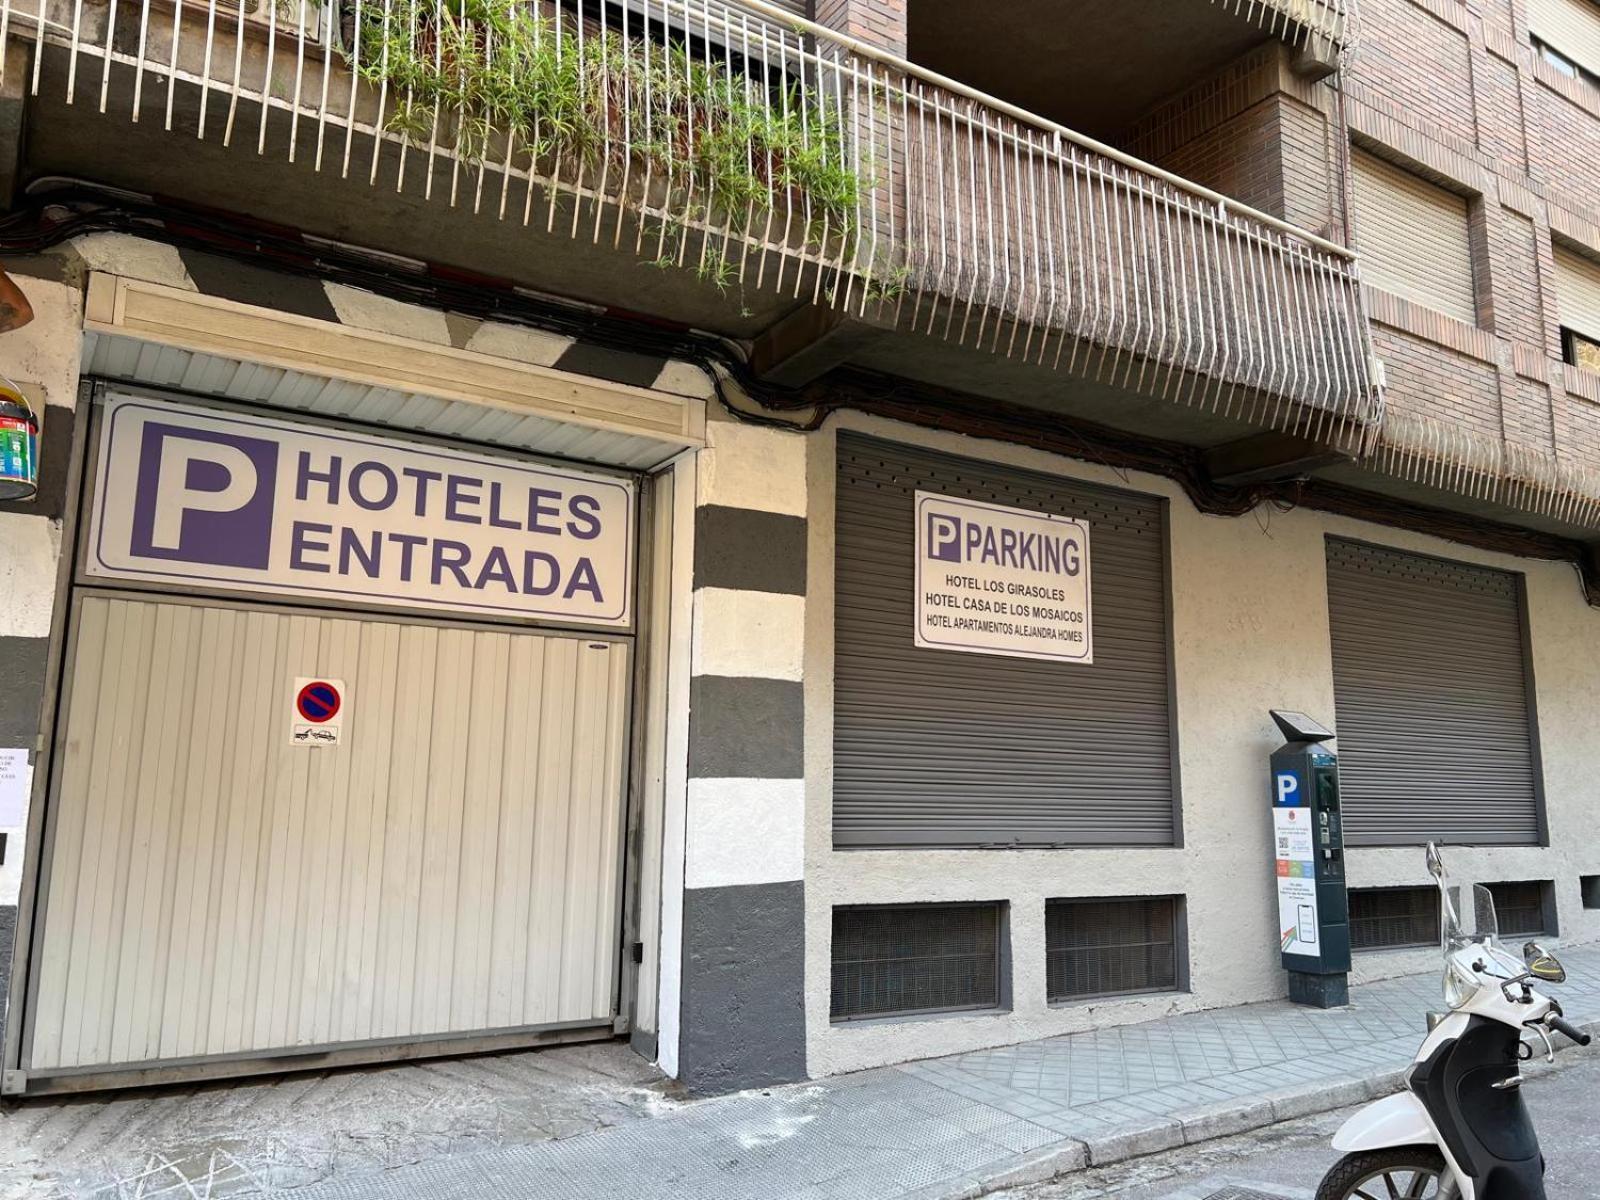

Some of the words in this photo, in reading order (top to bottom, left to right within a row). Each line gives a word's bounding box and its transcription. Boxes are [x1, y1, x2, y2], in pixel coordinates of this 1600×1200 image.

[151, 434, 258, 552] P
[295, 450, 602, 540] HOTELES
[289, 521, 605, 604] ENTRADA
[931, 516, 957, 557] P
[966, 522, 1080, 577] PARKING
[926, 592, 960, 609] HOTEL
[963, 597, 991, 612] CASA
[994, 601, 1007, 614] DE
[1010, 604, 1030, 617] LOS
[1032, 607, 1083, 623] MOSAICOS
[946, 574, 981, 590] HOTEL
[984, 580, 1005, 593] LOS
[1007, 583, 1065, 601] GIRASOLES
[926, 614, 952, 629] HOTEL
[953, 617, 1013, 636] APARTAMENTOS
[1014, 624, 1057, 640] ALEJANDRA
[1058, 629, 1083, 643] HOMES
[1277, 774, 1298, 802] P
